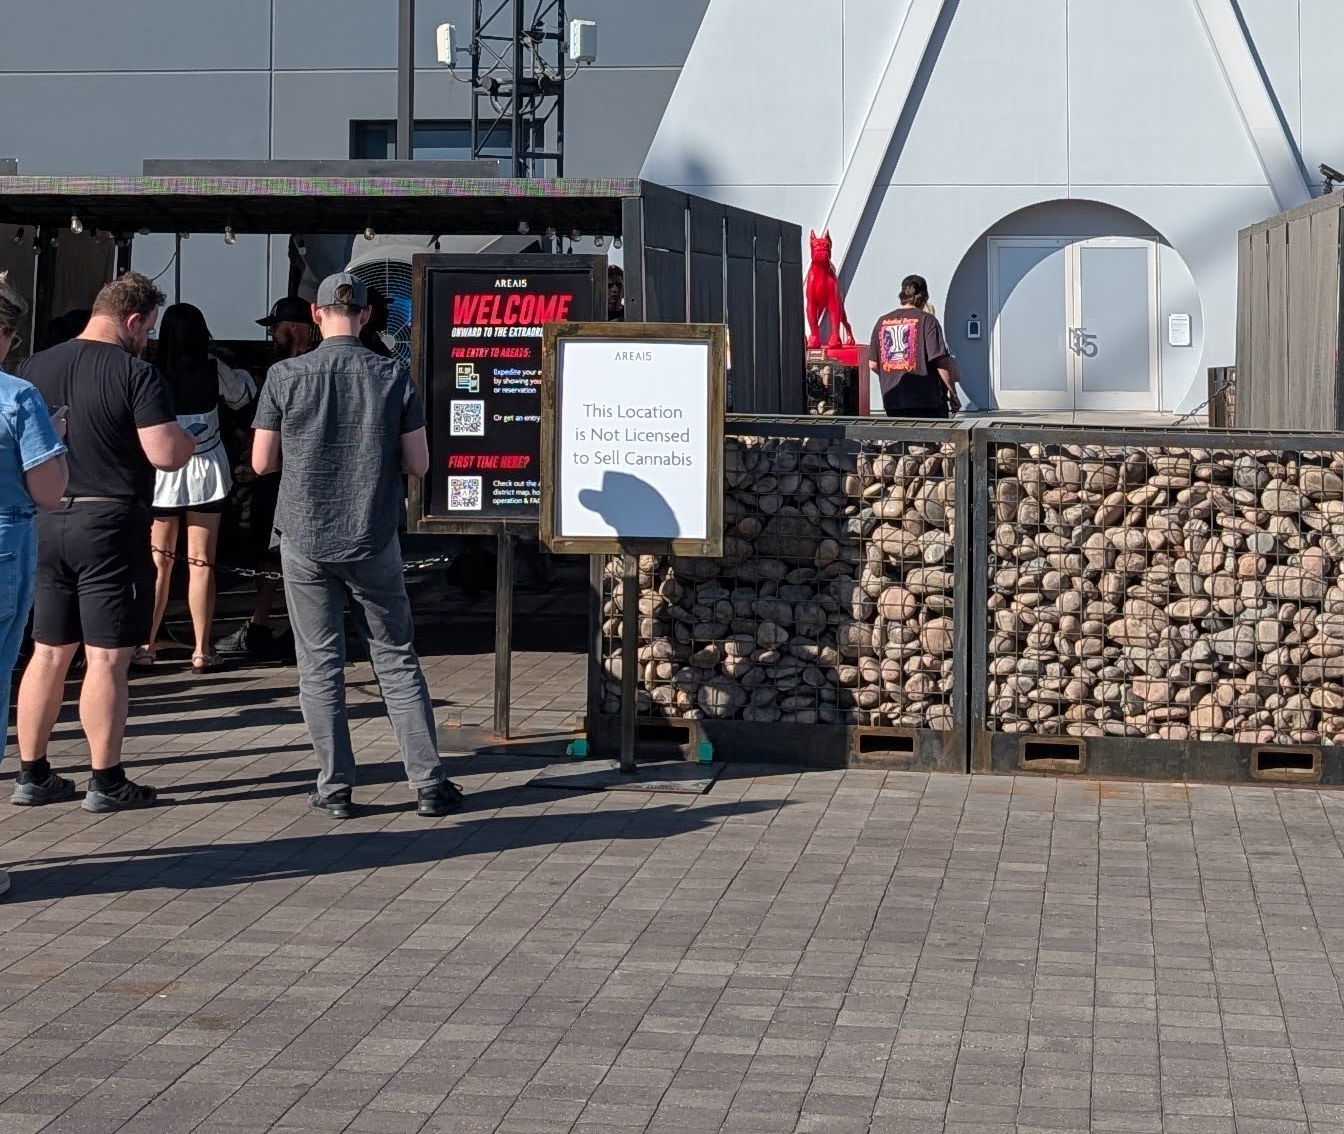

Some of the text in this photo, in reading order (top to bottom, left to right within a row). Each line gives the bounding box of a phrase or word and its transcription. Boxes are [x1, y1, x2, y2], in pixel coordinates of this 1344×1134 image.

[494, 279, 527, 287] AREA15
[453, 294, 572, 324] WELCOME
[451, 327, 482, 337] ONWARD
[483, 327, 492, 337] TO
[494, 327, 508, 337] THE
[451, 348, 465, 358] FOR
[466, 348, 488, 358] ENTRY
[490, 348, 500, 358] TO
[615, 352, 652, 361] AREA15
[493, 368, 521, 377] Expedite
[493, 377, 501, 386] by
[503, 377, 529, 386] showing
[583, 403, 683, 418] This Location
[503, 415, 514, 423] get
[524, 415, 541, 423] entry
[575, 428, 690, 442] is Not Licensed
[448, 456, 530, 468] FIRST TIME HERE?
[573, 450, 692, 466] to Sell Cannabis
